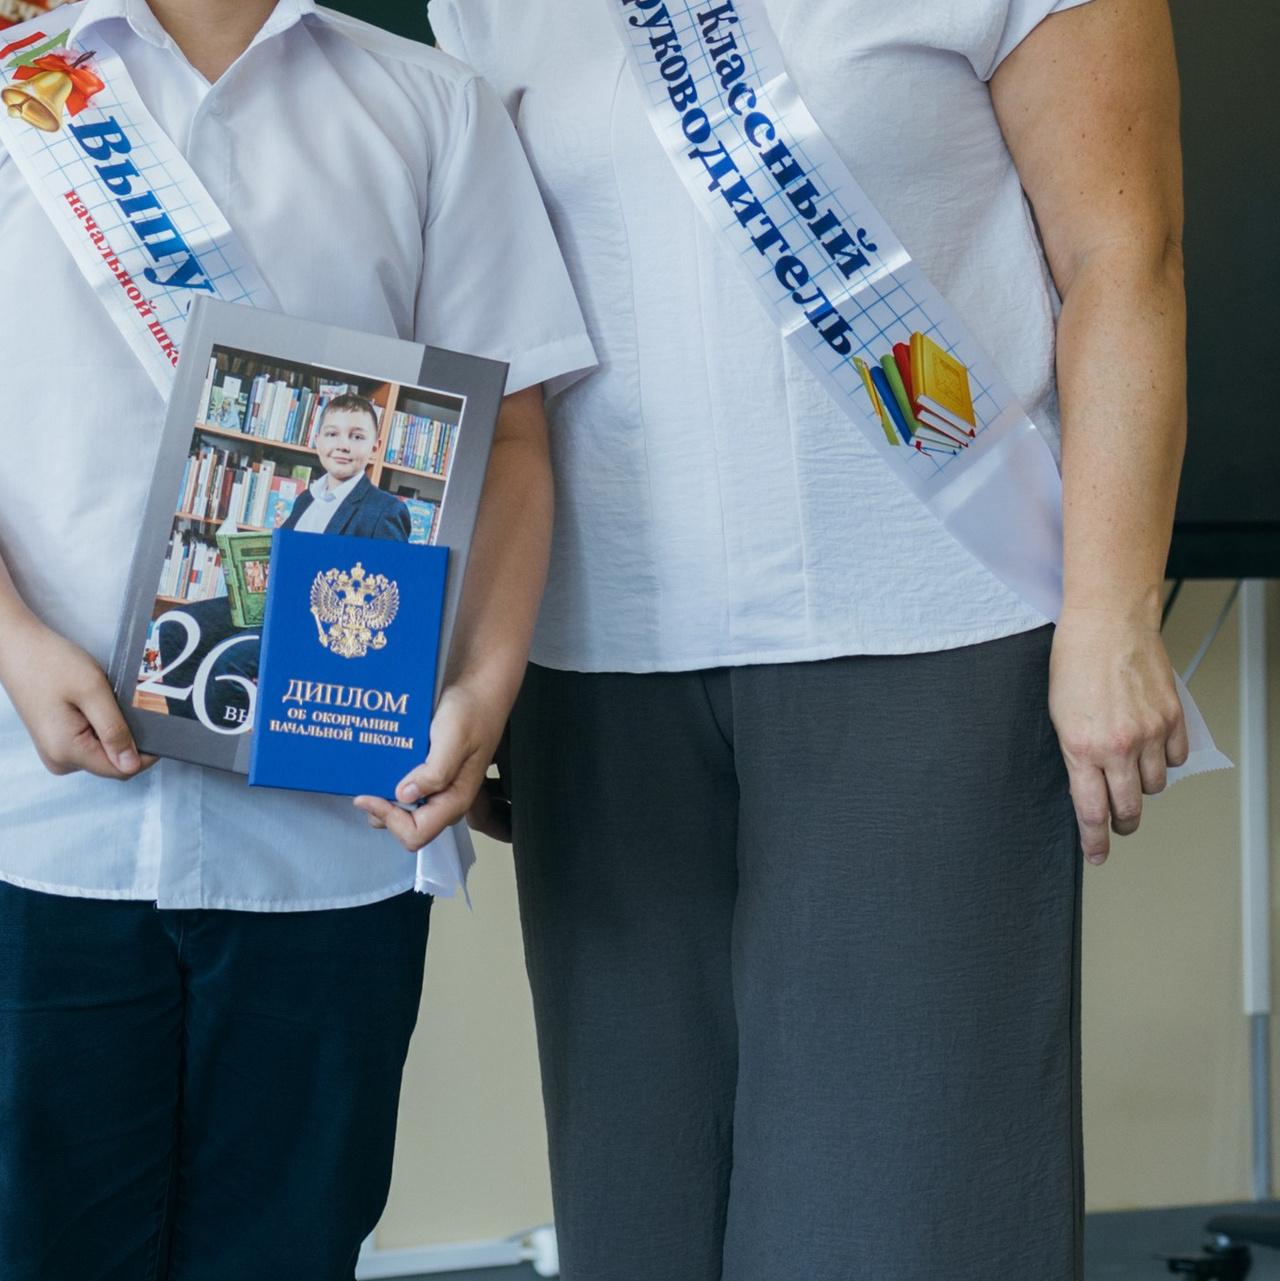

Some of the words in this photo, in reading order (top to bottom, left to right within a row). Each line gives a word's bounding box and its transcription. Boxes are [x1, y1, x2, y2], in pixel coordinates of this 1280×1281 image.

[697, 0, 878, 281] Классный
[63, 189, 157, 319] начальной
[67, 115, 216, 313] Выпу
[136, 610, 259, 735] 26
[269, 719, 353, 742] НАЧАЛЬНОЙ
[359, 731, 414, 750] ШКОЛЫ
[281, 678, 410, 715] ДИПЛОМ
[287, 707, 307, 720] ОБ
[311, 710, 399, 733] ОКОНЧАНИИ
